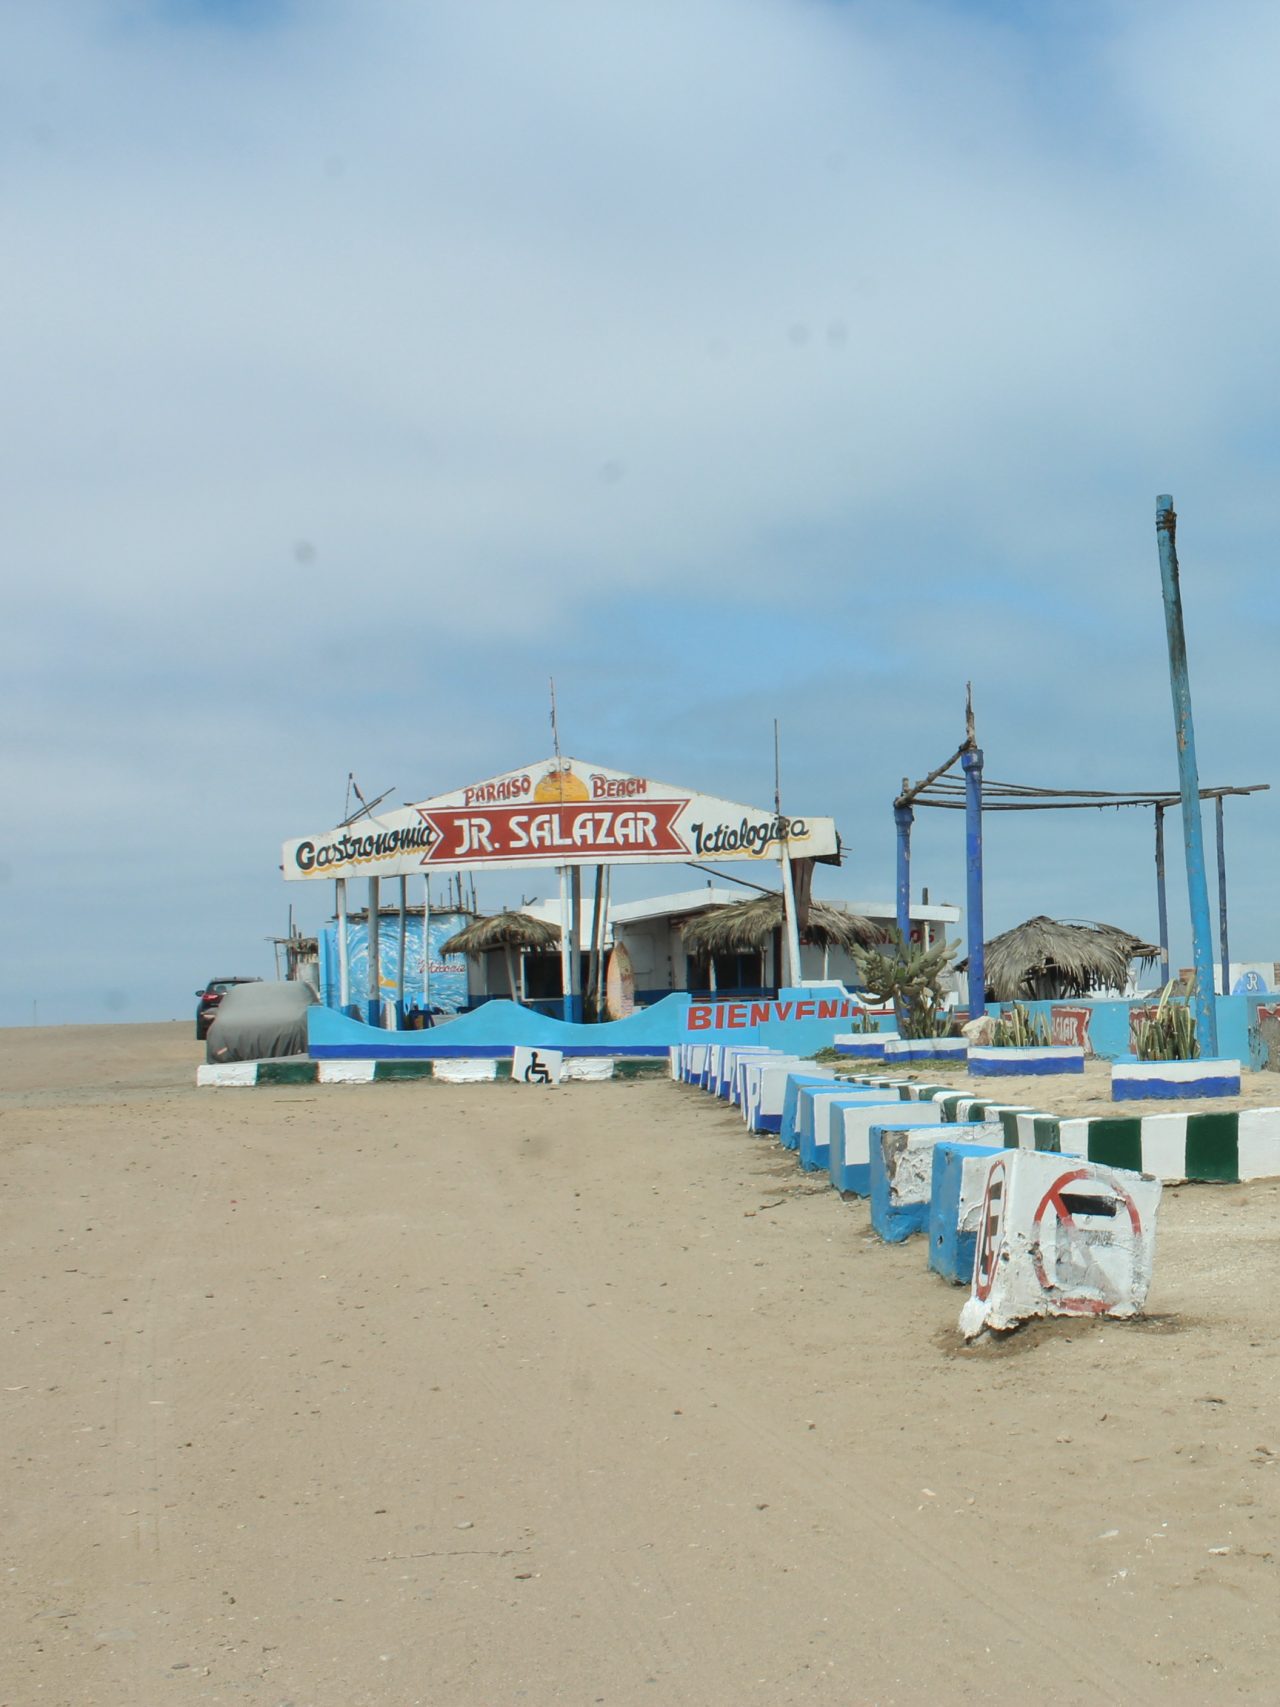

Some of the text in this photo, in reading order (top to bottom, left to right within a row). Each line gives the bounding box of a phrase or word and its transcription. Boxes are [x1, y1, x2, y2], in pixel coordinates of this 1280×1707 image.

[464, 775, 532, 806] PARAISO
[453, 811, 658, 855] JR. SALAZAR
